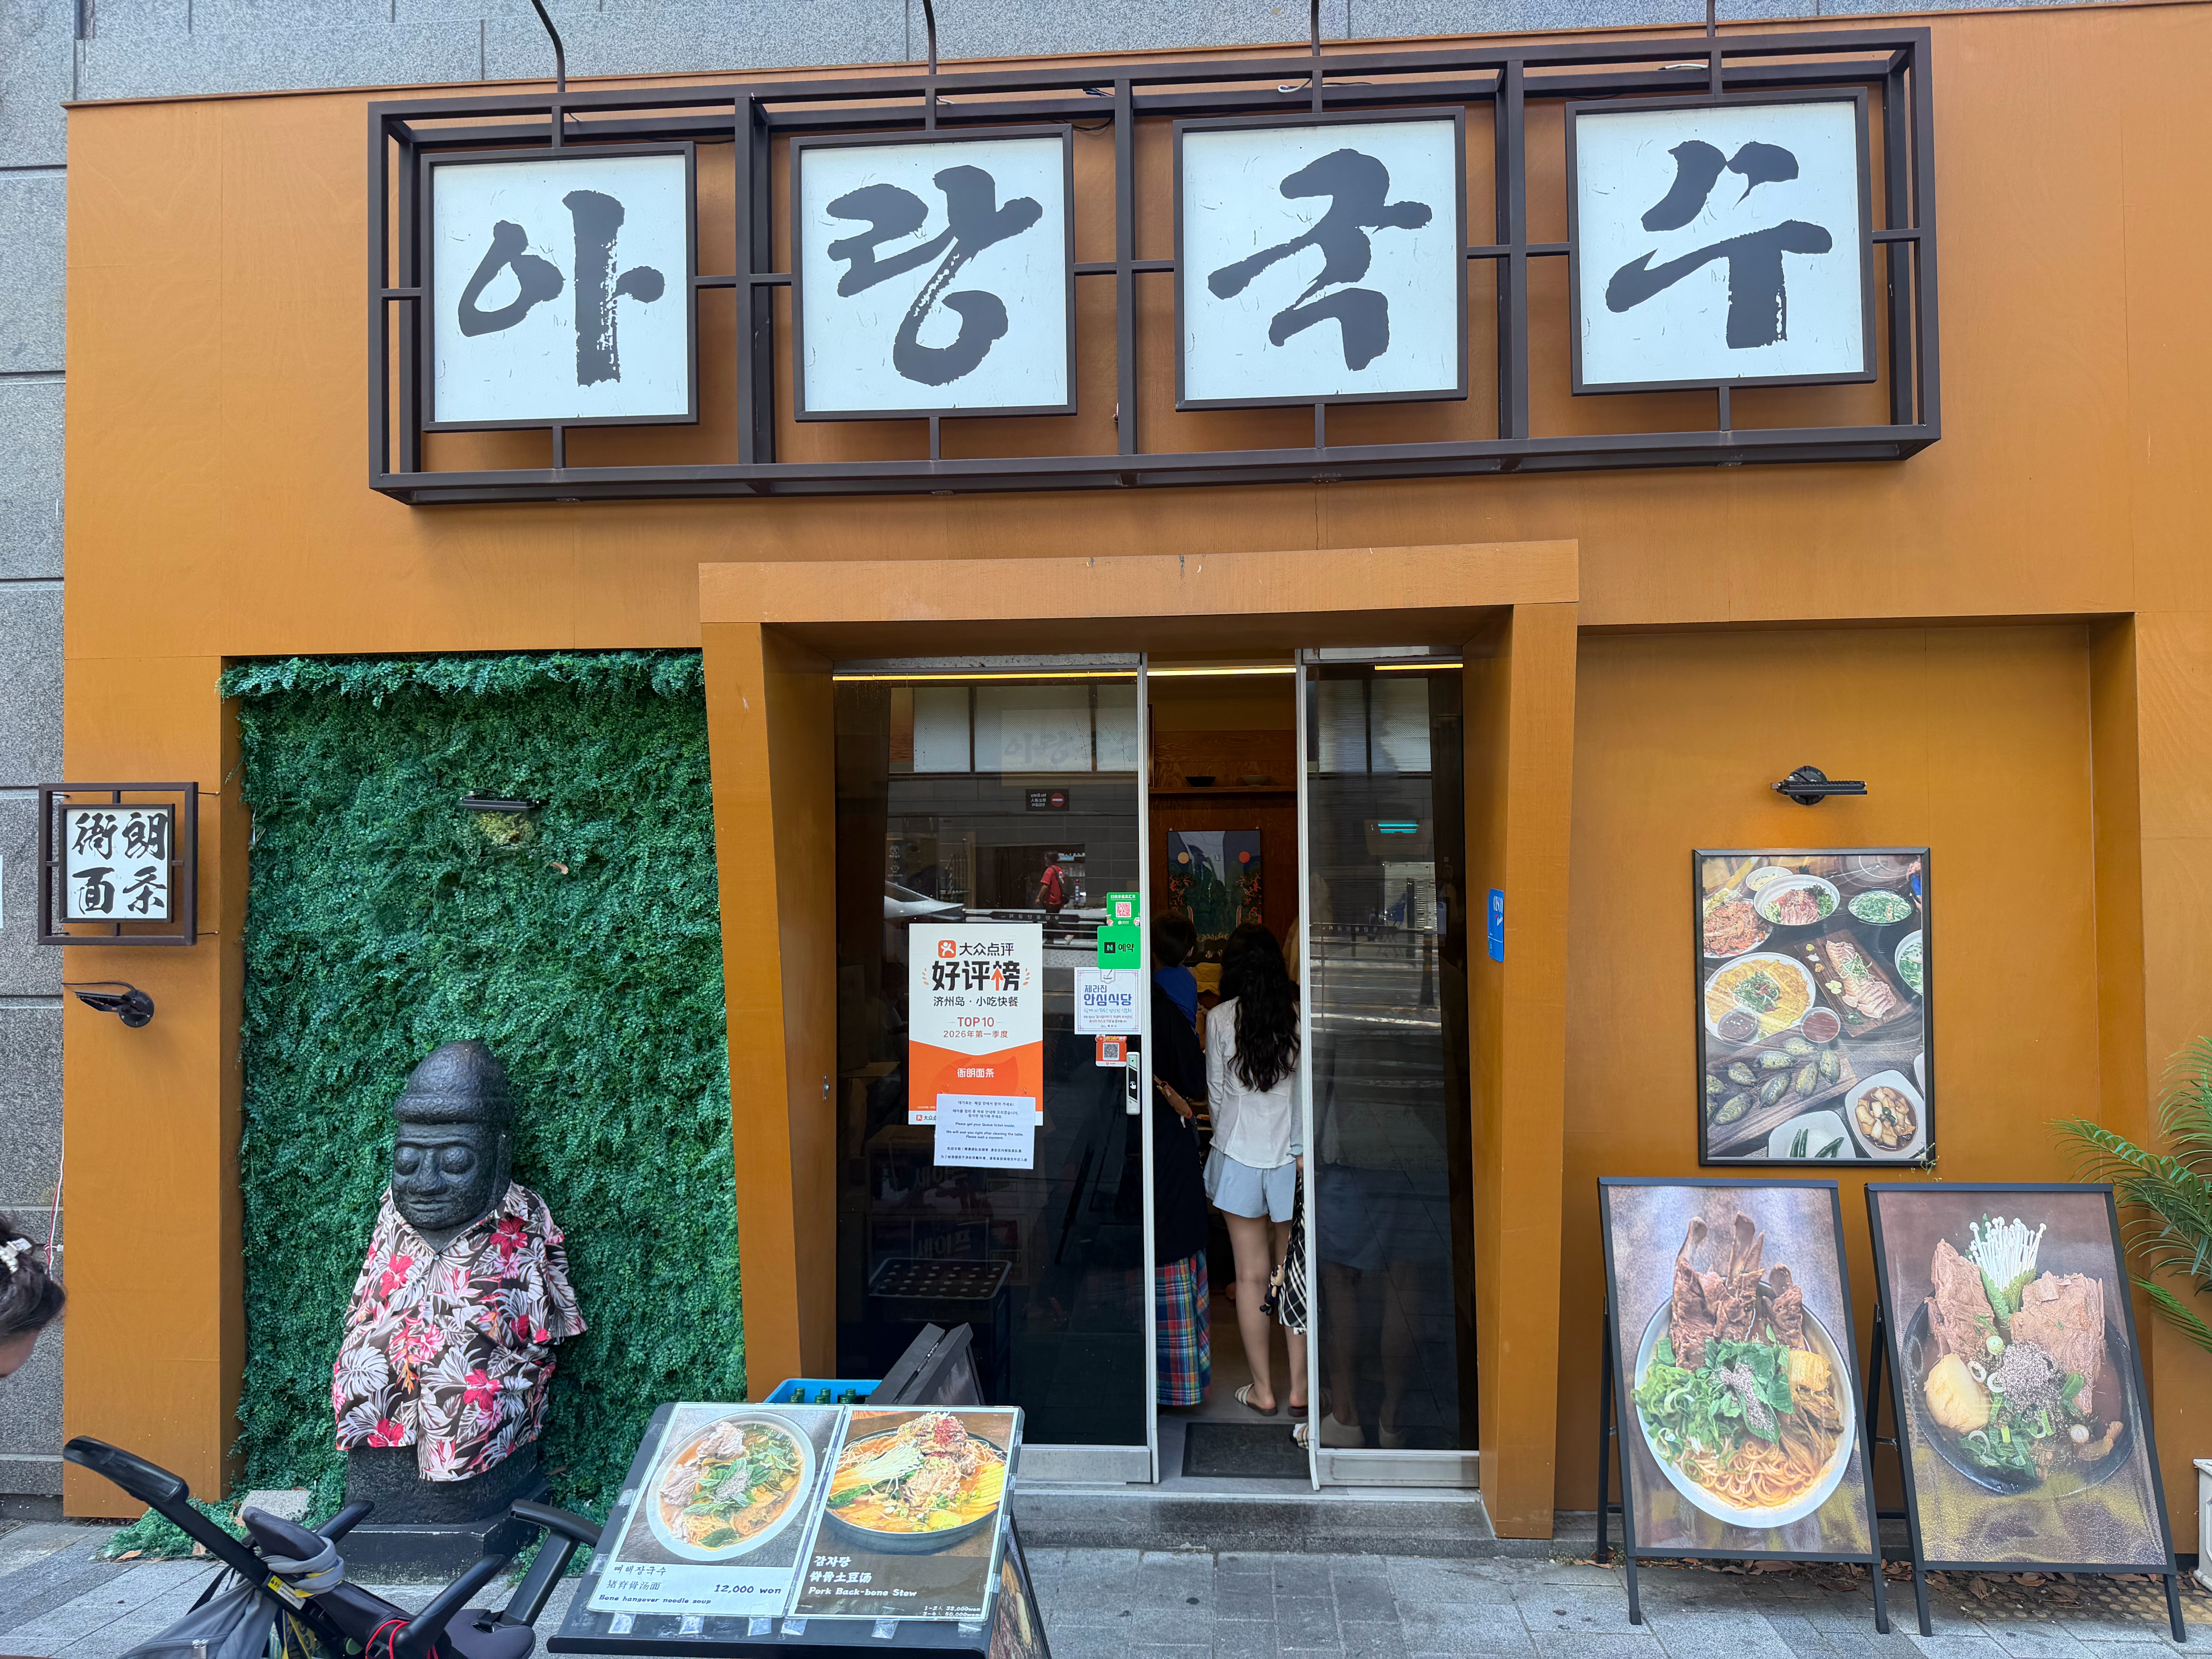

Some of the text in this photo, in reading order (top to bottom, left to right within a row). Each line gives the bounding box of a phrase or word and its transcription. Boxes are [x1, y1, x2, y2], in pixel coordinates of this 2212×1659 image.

[458, 140, 1832, 387] 아랑국수
[959, 942, 1014, 956] 大众点评
[1118, 943, 1134, 952] 예약
[932, 960, 1020, 991] 好评榜
[1085, 985, 1107, 993] 제라진
[1084, 994, 1132, 1006] 안심식당
[957, 1068, 994, 1078] 衙朗面条
[814, 1555, 851, 1568] 감자탕
[810, 1571, 872, 1583] 脊骨土豆汤
[606, 1579, 662, 1590] 猪脊骨汤面
[714, 1584, 754, 1593] 12,000
[809, 1587, 917, 1597] Pork Back-bone Stew
